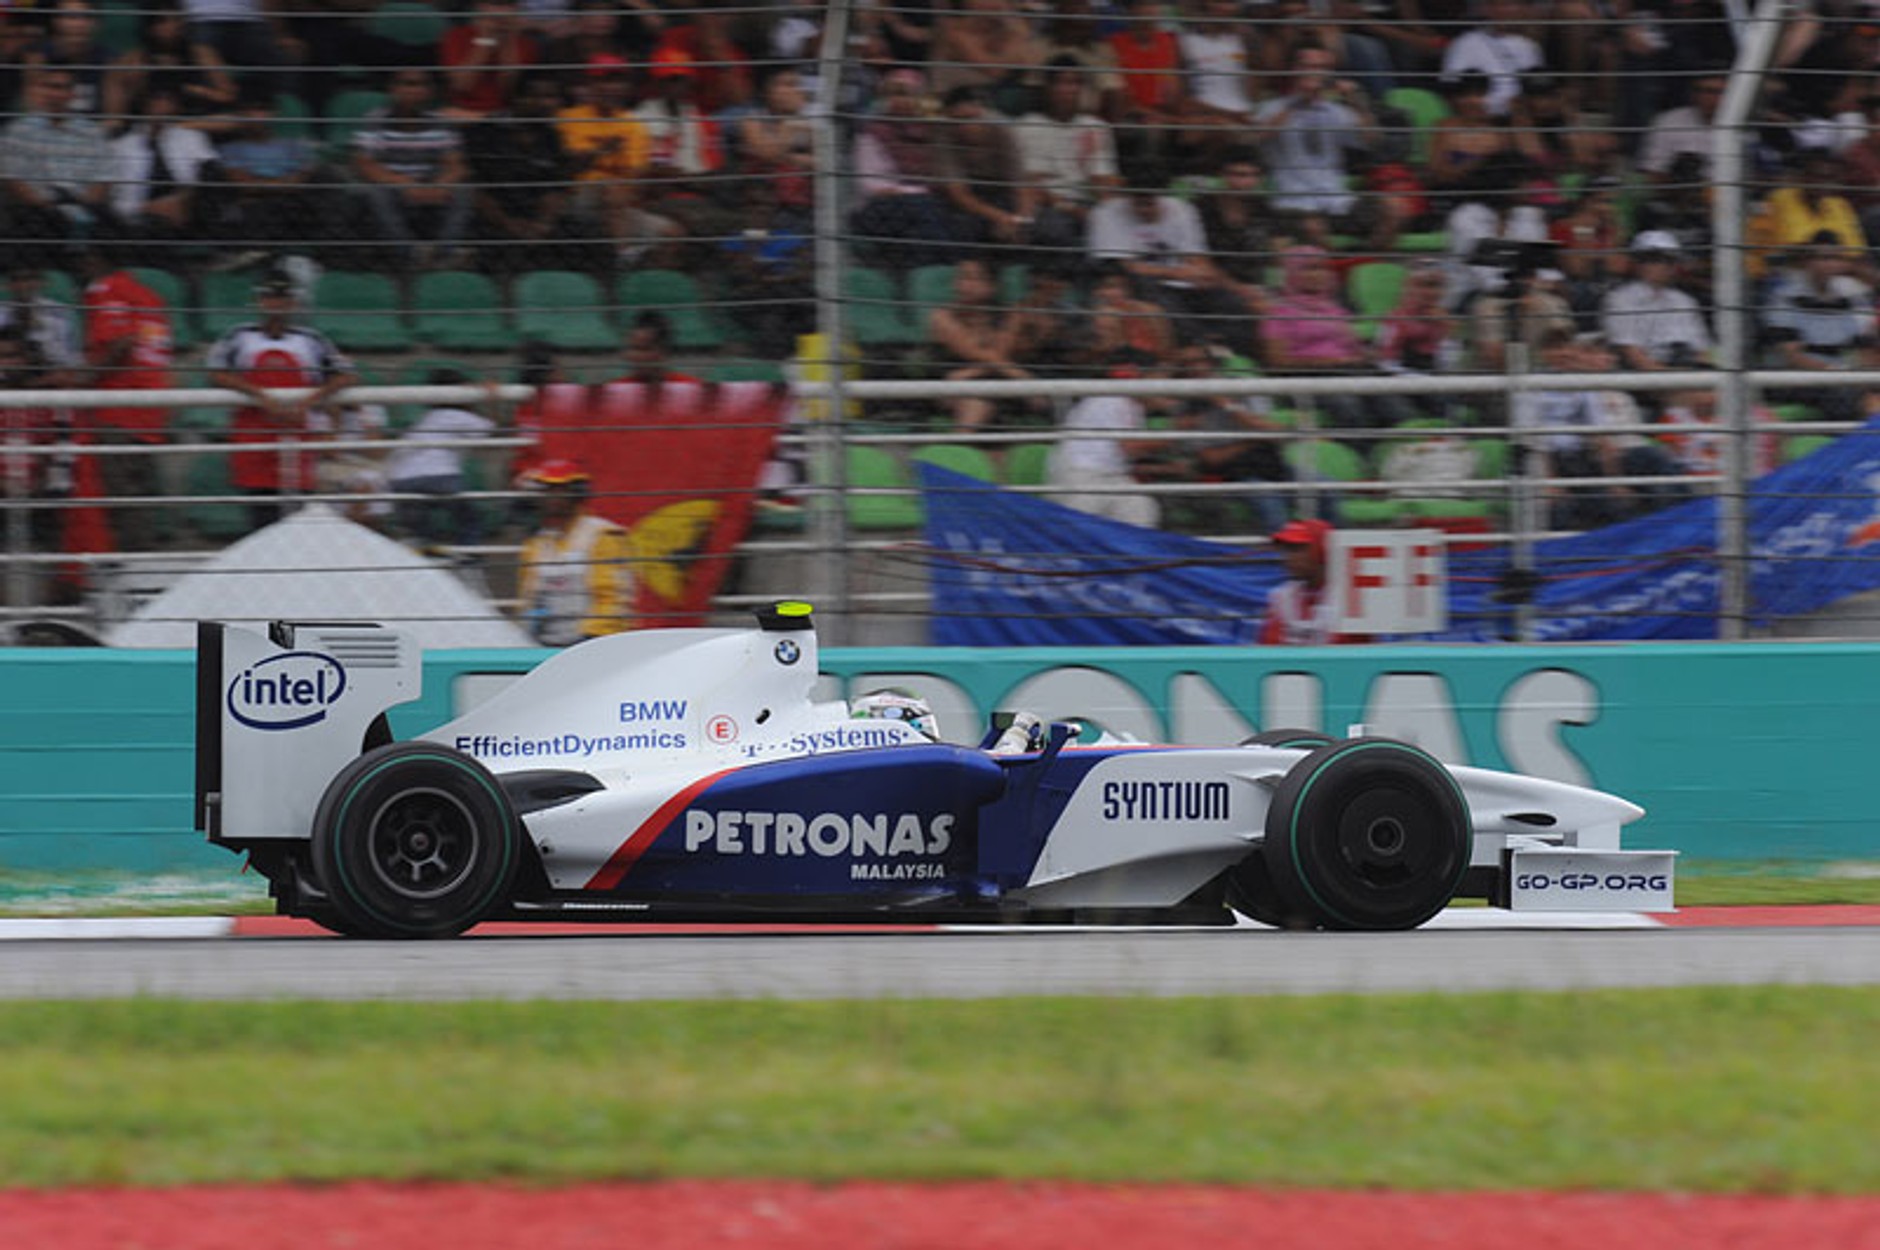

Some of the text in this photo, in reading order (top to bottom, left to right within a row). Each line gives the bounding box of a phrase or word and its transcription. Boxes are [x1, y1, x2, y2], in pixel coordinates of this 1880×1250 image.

[244, 669, 325, 705] intel
[619, 700, 688, 722] BMW
[455, 729, 687, 758] EfficientDynamics
[1103, 782, 1230, 820] SYNTIUM
[685, 809, 955, 857] PETRONAS
[850, 863, 946, 880] MALAYSIA
[1516, 873, 1668, 891] GO-GP.ORG
